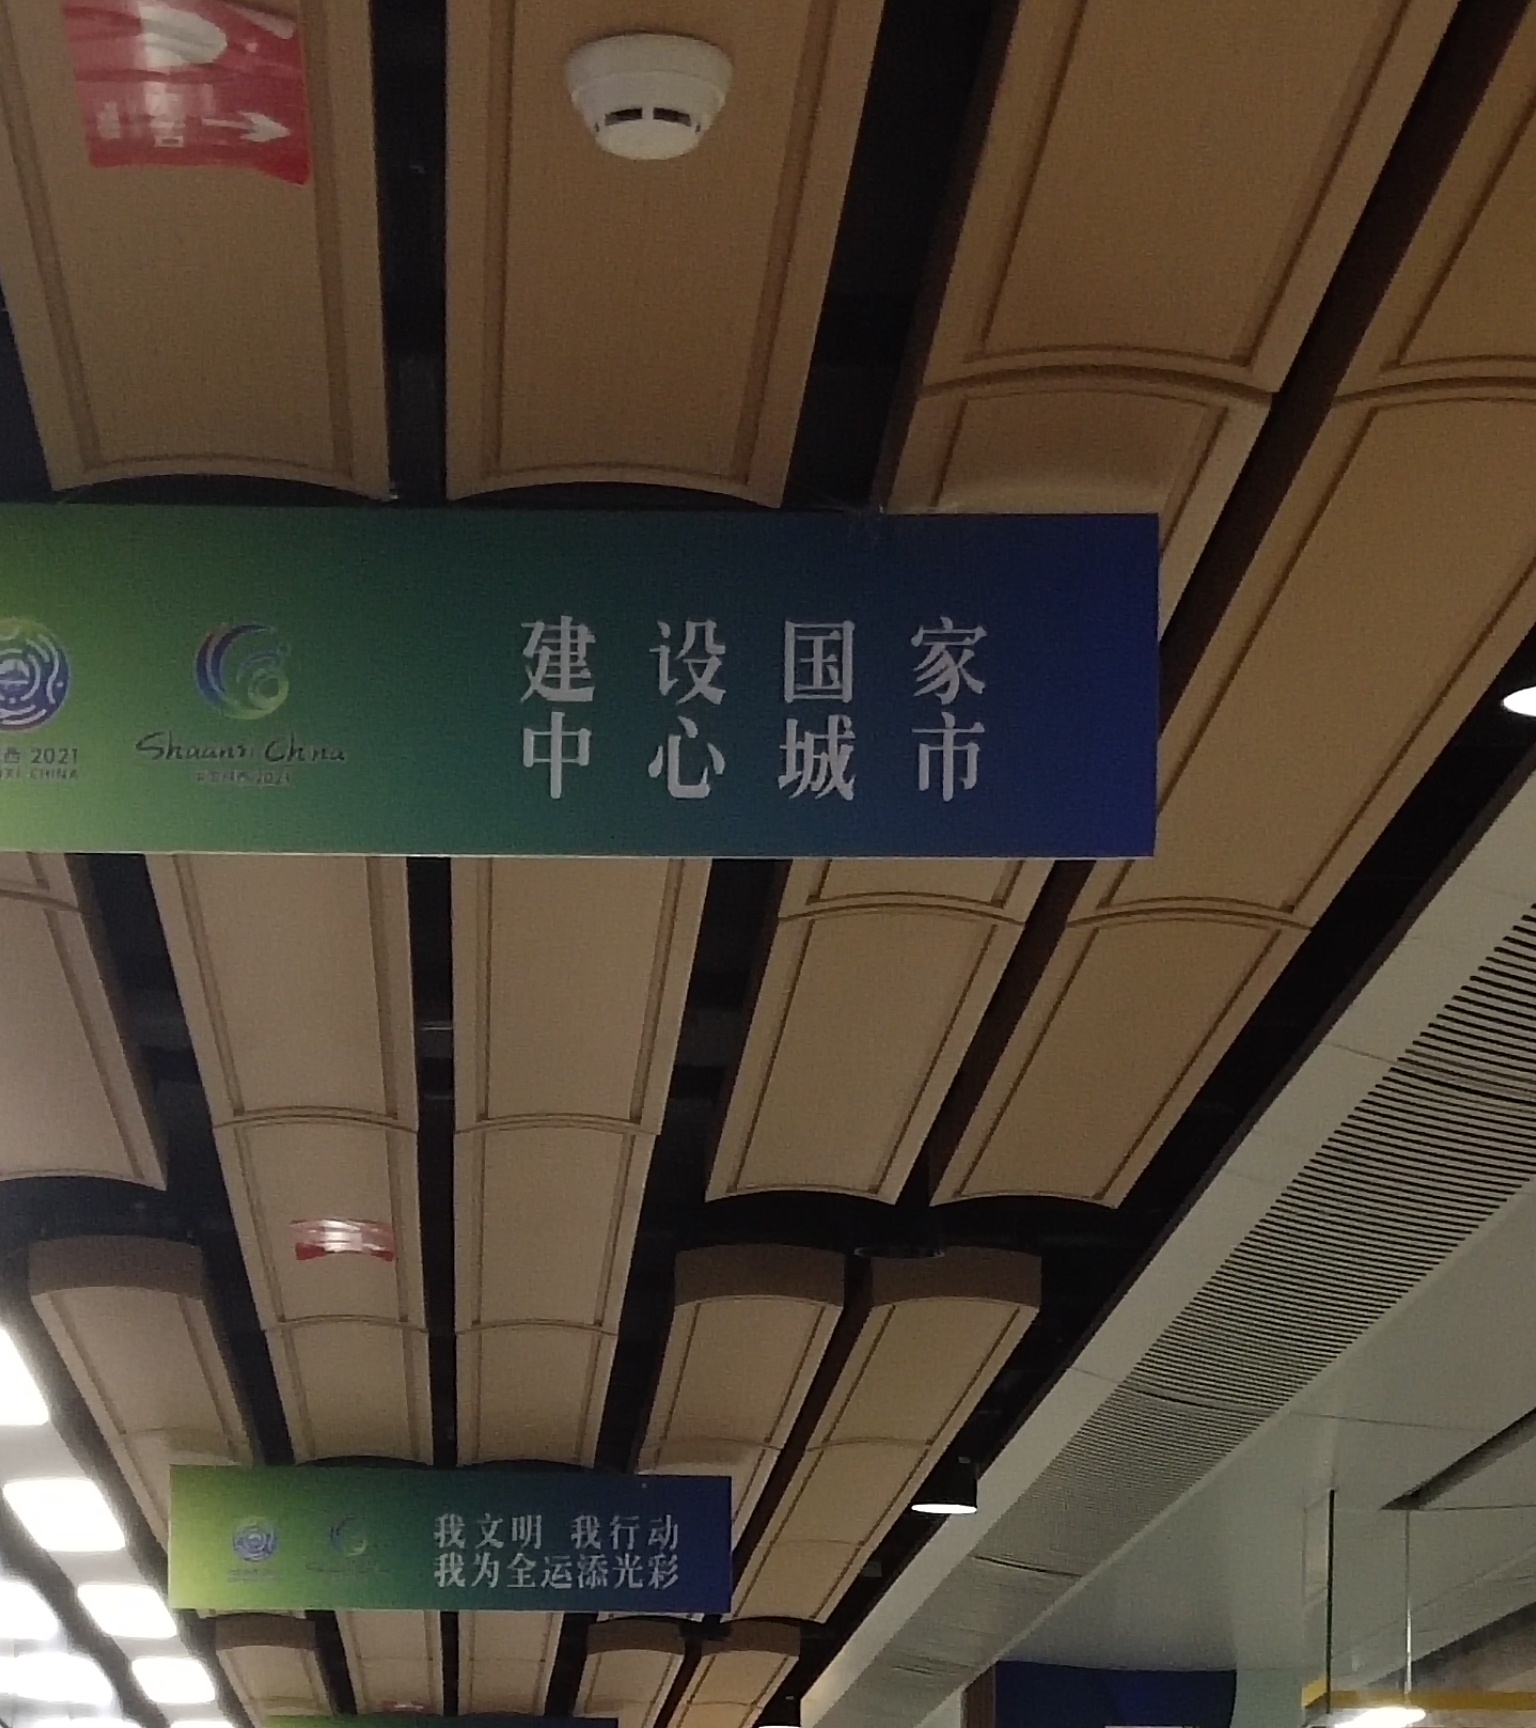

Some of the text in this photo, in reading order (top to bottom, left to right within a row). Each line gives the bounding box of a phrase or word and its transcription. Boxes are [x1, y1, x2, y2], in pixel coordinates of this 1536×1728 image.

[520, 615, 988, 704] 建设国家
[31, 748, 79, 765] 2021
[522, 711, 986, 802] 中心城市
[432, 1514, 679, 1551] 我文明 我行动
[432, 1552, 679, 1590] 我为全运添光彩
